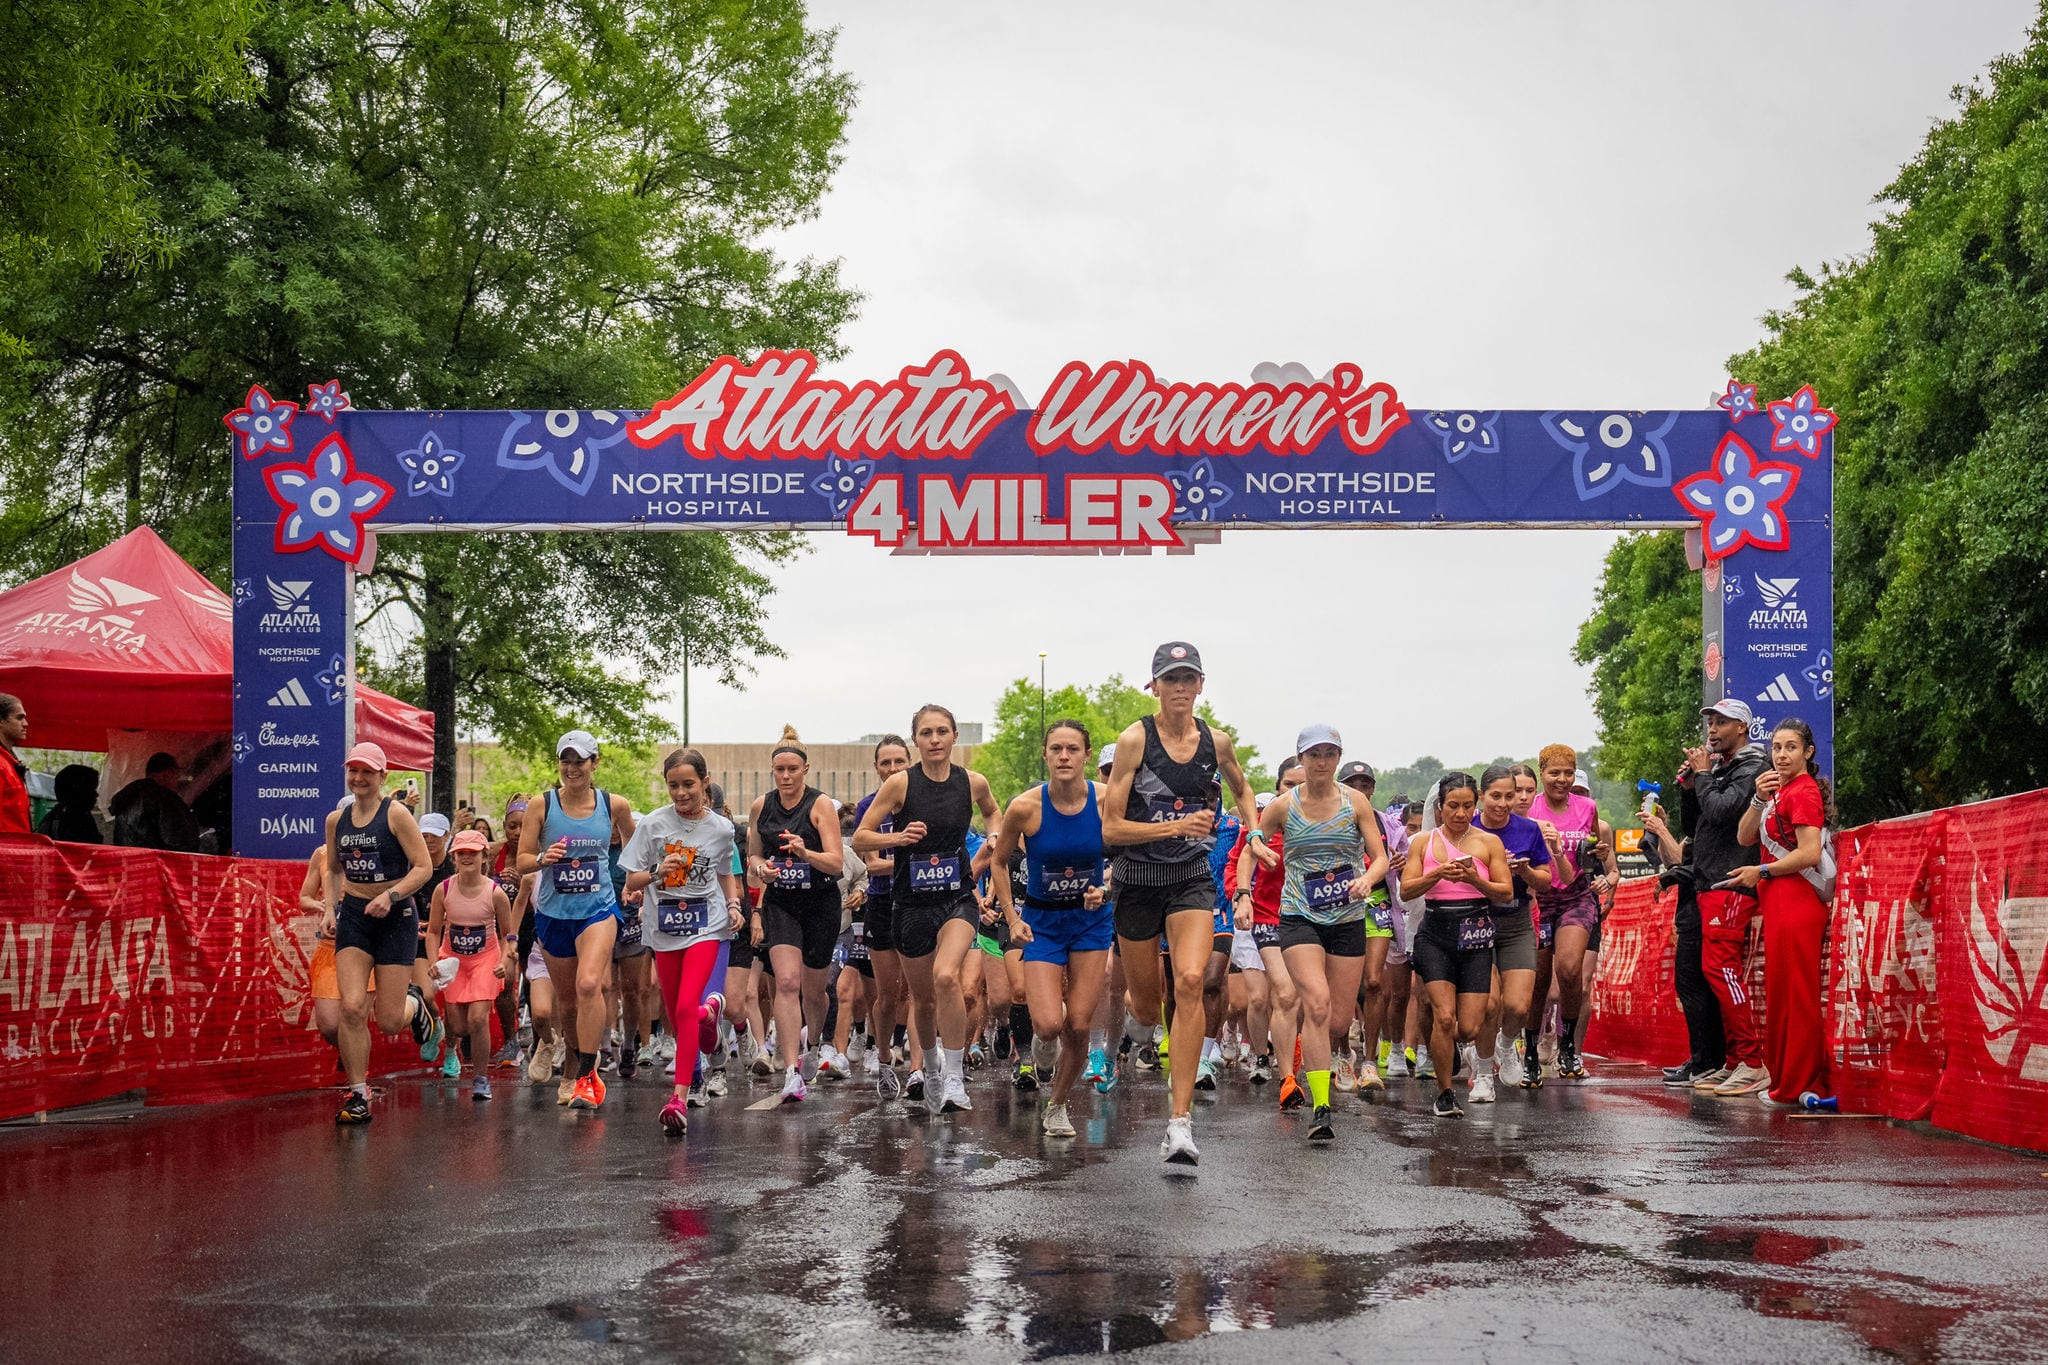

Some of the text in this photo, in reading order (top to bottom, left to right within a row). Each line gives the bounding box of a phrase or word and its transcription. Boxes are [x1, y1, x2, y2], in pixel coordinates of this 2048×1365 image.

[634, 356, 1399, 452] Atlanta Women's
[611, 472, 805, 495] NORTHSIDE
[1245, 471, 1436, 493] NORTHSIDE
[647, 500, 770, 516] HOSPITAL
[852, 479, 1172, 541] 4 MILER
[1279, 499, 1401, 515] HOSPITAL
[259, 613, 321, 627] ATLANTA
[1748, 609, 1808, 623] ATLANTA
[16, 612, 148, 649] ATLANTA
[12, 626, 140, 654] TRACK CLUB
[1748, 643, 1808, 651] NORTHSIDE
[259, 647, 321, 656] NORTHSIDE
[258, 763, 320, 773] GARMIN
[258, 787, 320, 799] BODYARMOR
[1151, 810, 1193, 823] A37
[260, 813, 317, 840] DASANI
[571, 839, 602, 847] STRIDE
[346, 859, 376, 871] A596
[558, 868, 594, 882] A500
[916, 865, 954, 880] A489
[1048, 878, 1089, 892] A947
[1313, 879, 1349, 899] A939
[663, 911, 701, 925] A391
[453, 935, 482, 946] A399
[1463, 927, 1493, 940] A406
[0, 915, 174, 1011] ATLANTA
